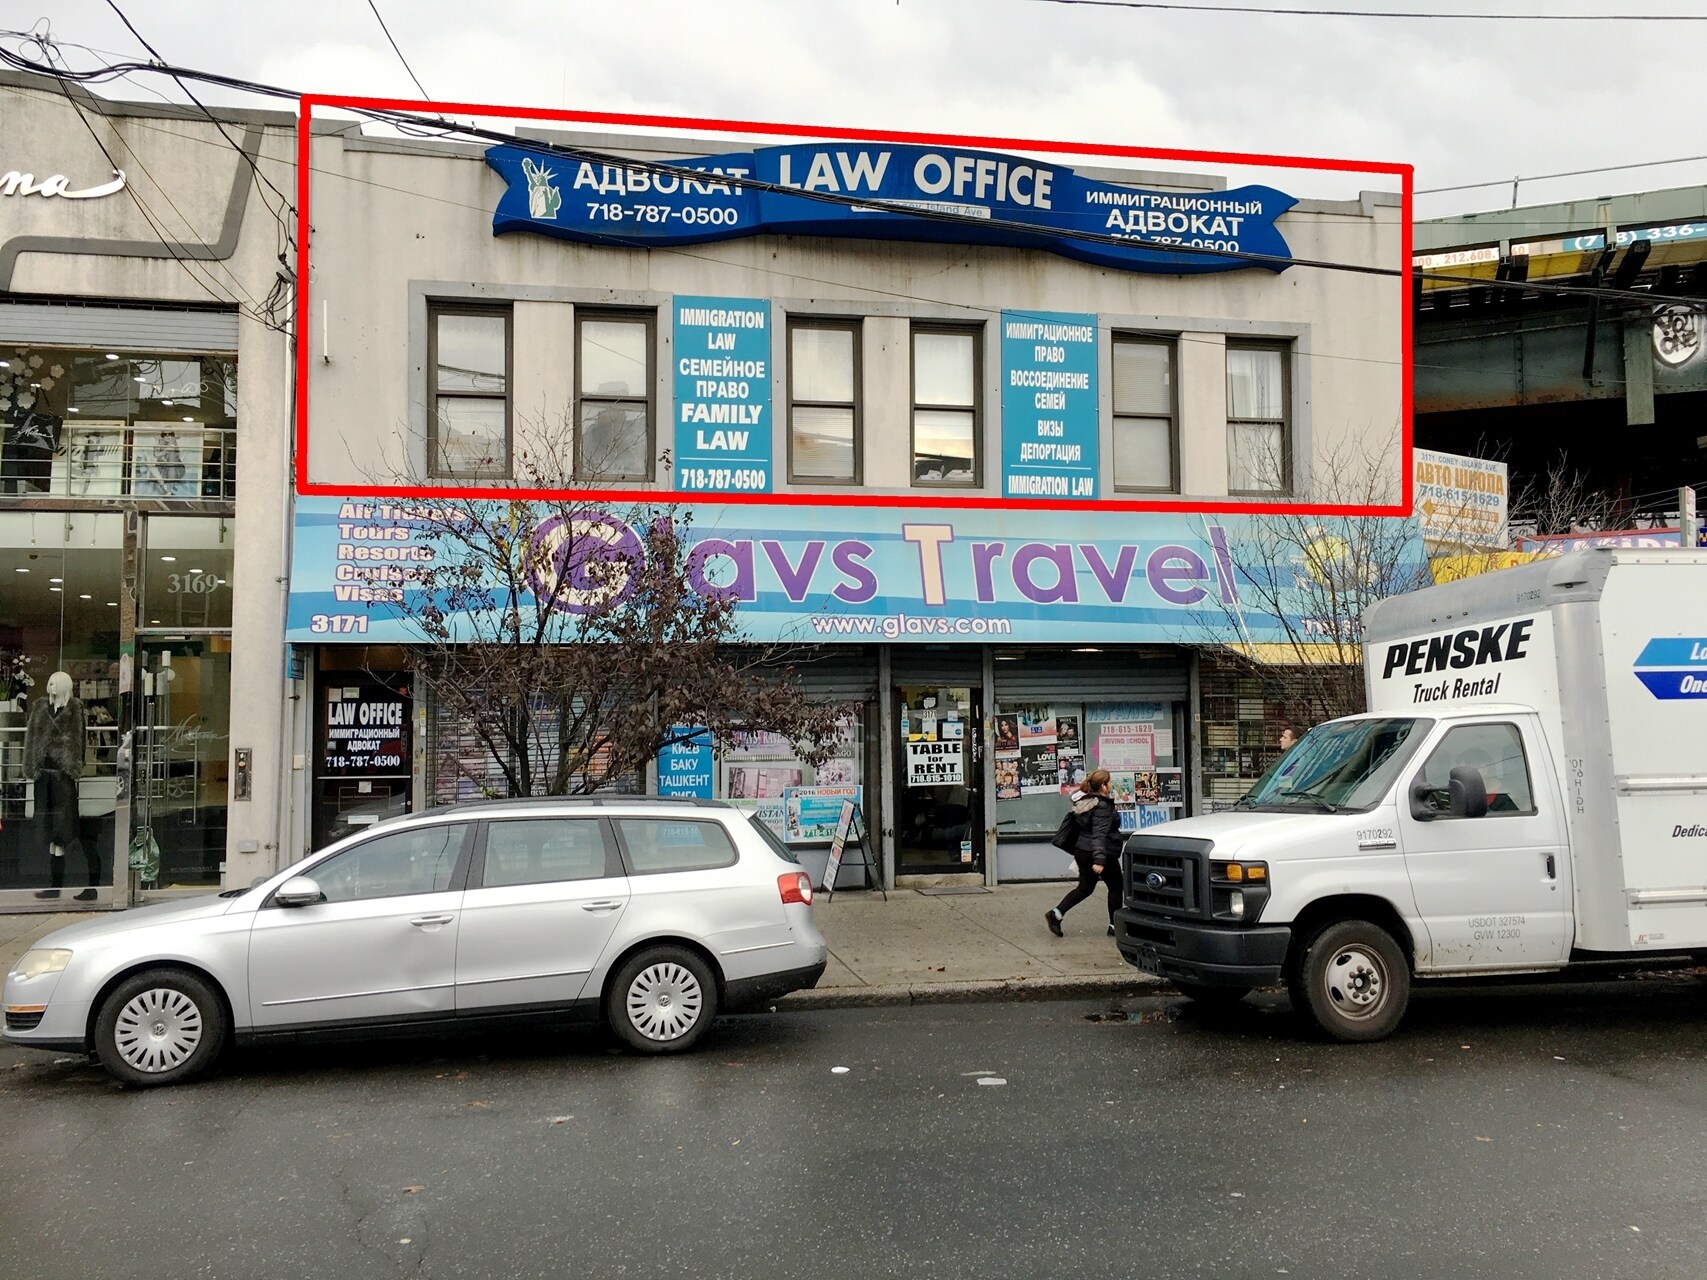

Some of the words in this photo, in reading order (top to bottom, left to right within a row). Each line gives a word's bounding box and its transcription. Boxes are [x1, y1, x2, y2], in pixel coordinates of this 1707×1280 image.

[573, 161, 749, 195] АДВОКАТ
[780, 152, 892, 192] LAW
[913, 154, 1053, 210] OFFICE
[1086, 191, 1262, 215] ИММИГРАЦИОННЫЙ
[586, 203, 738, 225] 718-787-0500
[1105, 208, 1244, 236] АДВОКАТ
[1110, 233, 1239, 253] 787-0500
[1575, 231, 1637, 250] (78)
[680, 308, 764, 329] IMMIGRATION
[707, 333, 736, 350] LAW
[1006, 322, 1093, 344] ИММИГРАЦИОННОЕ
[1034, 345, 1065, 363] ПРАВО
[679, 356, 765, 378] СЕМЕЙНОЕ
[696, 380, 749, 399] ПРАВО
[1010, 370, 1089, 391] ВОССОЕДИНЕНИЕ
[1034, 391, 1066, 410] СЕМЕЙ
[681, 403, 763, 425] FAMILY
[1037, 420, 1064, 437] ВИЗЫ
[696, 430, 749, 451] LAW
[1020, 442, 1081, 463] ДЕПОРТАЦИЯ
[681, 468, 766, 490] 718-787-0500
[1416, 461, 1452, 488] АВТО
[1008, 474, 1069, 496] IMMIGRATION
[1072, 476, 1094, 497] LAW
[338, 502, 376, 520] Air
[338, 523, 409, 540] Tours
[337, 543, 435, 562] Resorts
[526, 511, 880, 613] Gavs
[901, 522, 1240, 607] Travel
[166, 573, 219, 594] 3169
[333, 584, 404, 603] Visas
[310, 613, 369, 633] 3171
[811, 613, 1012, 639] www.glavs.com
[1382, 619, 1535, 680] PENSKE
[1413, 680, 1450, 703] Truck
[1452, 672, 1501, 699] Rental
[328, 702, 357, 726] LAW
[359, 702, 403, 726] OFFICE
[328, 726, 401, 740] ИММИГРАЦИОННЫЙ
[1103, 725, 1152, 734] 718-615-1629
[347, 740, 381, 753] АДВОКАТ
[910, 743, 961, 755] TABLE
[326, 755, 401, 768] 718-787-0500
[670, 758, 699, 771] БАКУ
[914, 763, 958, 774] RENT
[928, 755, 944, 763] for
[659, 774, 710, 787] ТАШКЕНТ
[1356, 828, 1394, 840] 9170292
[1468, 917, 1497, 928] USDOT
[1498, 915, 1526, 927] 327574
[1473, 929, 1495, 940] GVW
[1497, 928, 1521, 939] 12300
